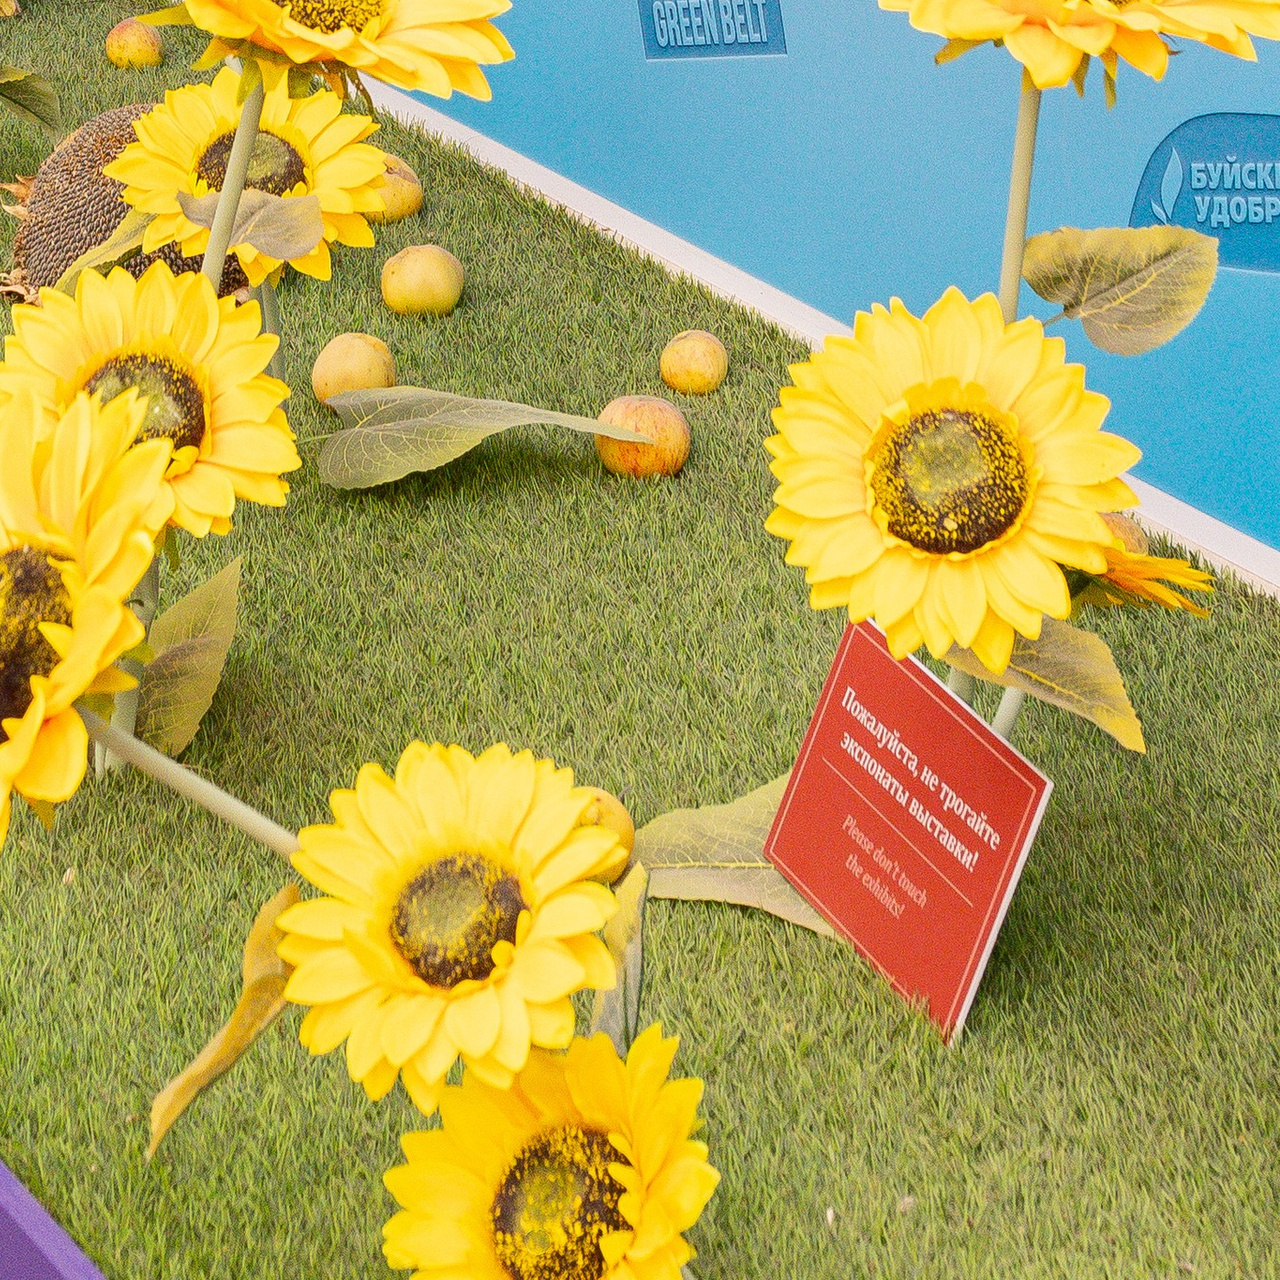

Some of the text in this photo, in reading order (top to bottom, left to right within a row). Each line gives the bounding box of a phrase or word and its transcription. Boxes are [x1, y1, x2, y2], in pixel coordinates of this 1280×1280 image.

[840, 732, 979, 873] экспонаты выставки!
[841, 686, 1001, 852] Пожалуйста, не трогайте
[841, 814, 874, 854] Please
[898, 867, 928, 908] touch
[845, 854, 906, 919] the exhibits!
